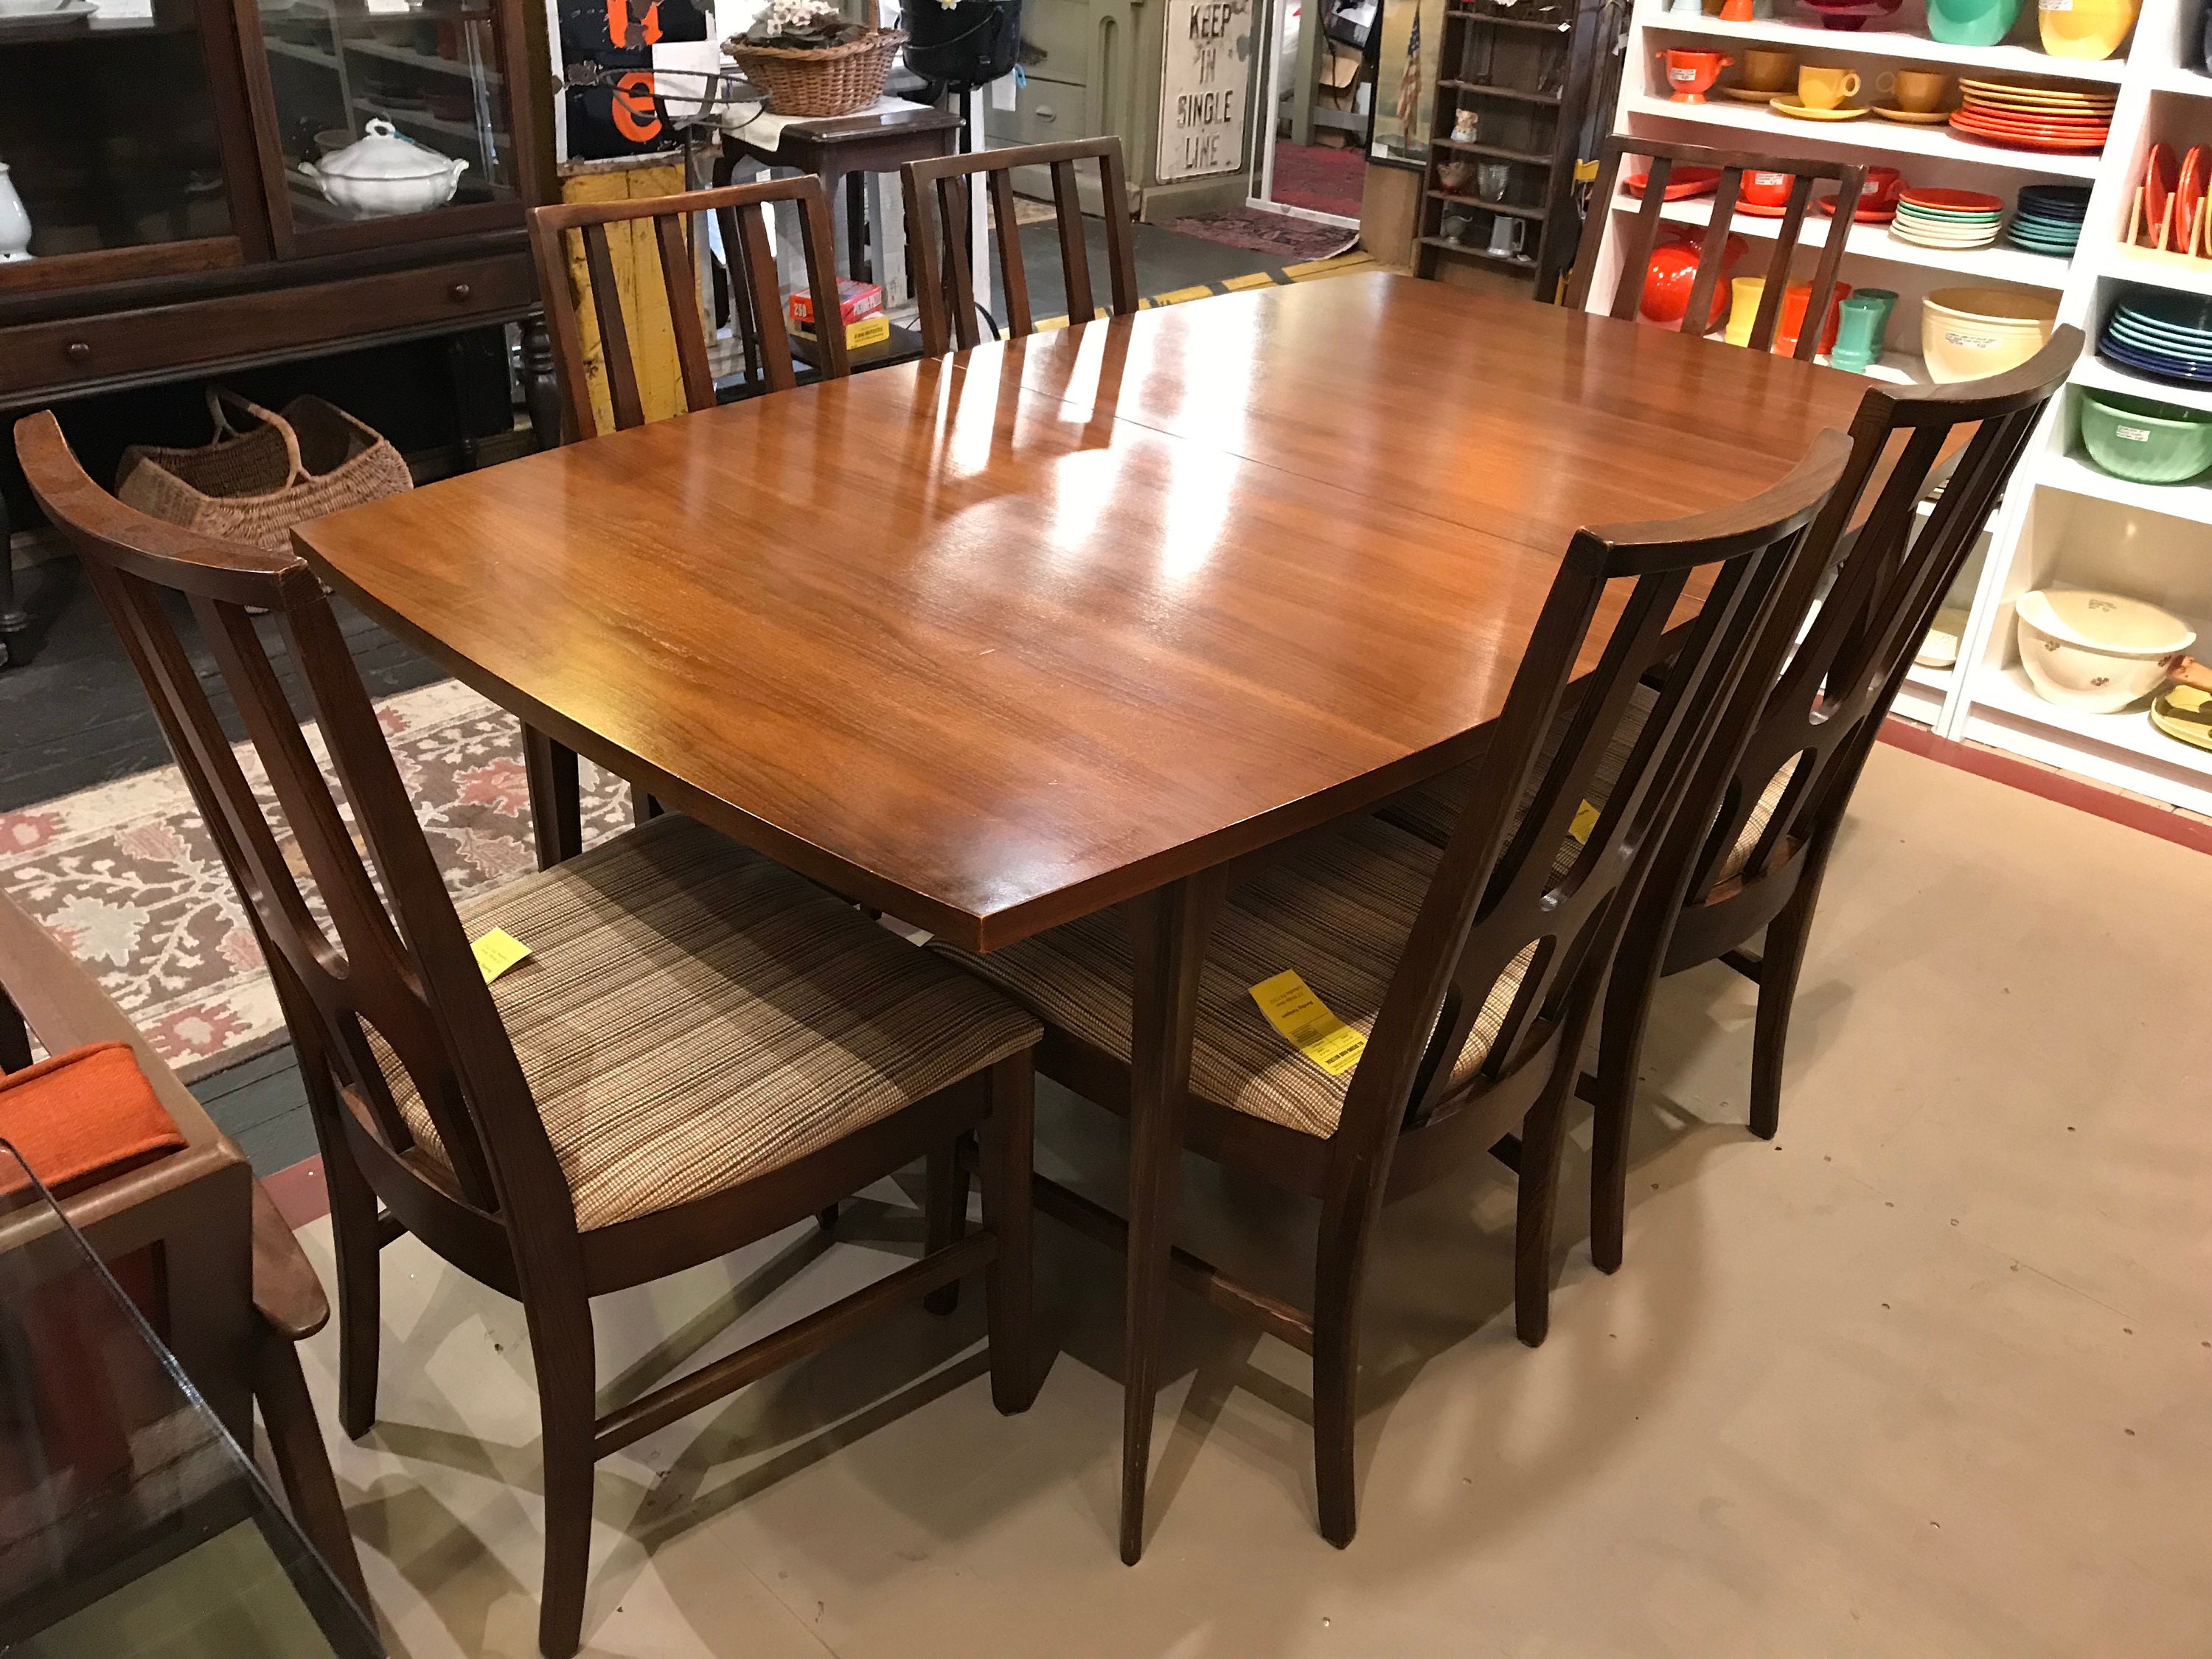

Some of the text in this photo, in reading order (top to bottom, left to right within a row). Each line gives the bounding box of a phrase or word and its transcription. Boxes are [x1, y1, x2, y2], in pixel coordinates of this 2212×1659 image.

[1189, 4, 1232, 40] KEEP
[1199, 48, 1217, 85] IN
[1176, 90, 1234, 128] SINGLE
[1184, 133, 1220, 170] LINE
